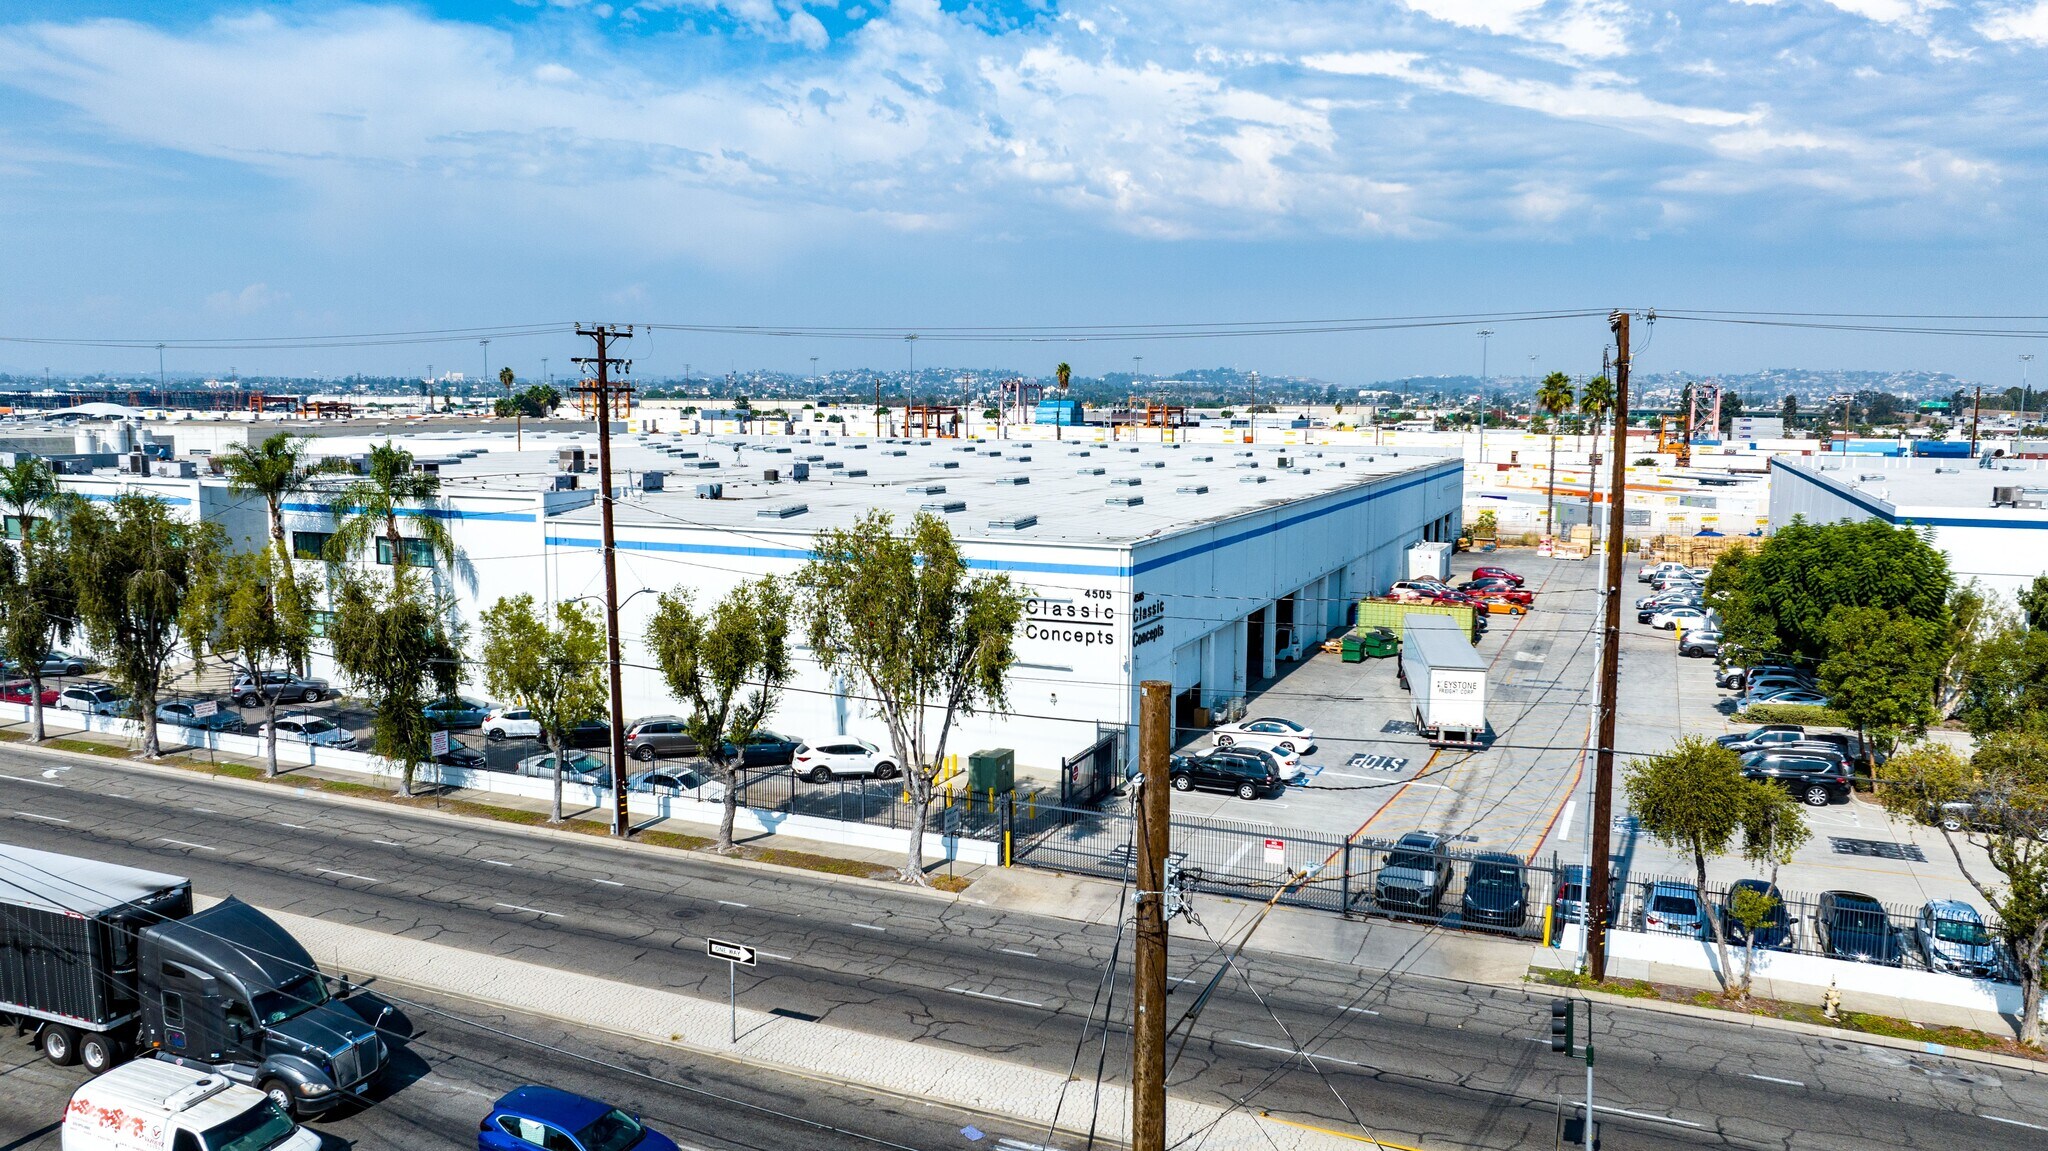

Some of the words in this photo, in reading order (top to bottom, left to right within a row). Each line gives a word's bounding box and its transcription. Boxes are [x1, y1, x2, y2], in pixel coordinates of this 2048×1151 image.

[1084, 589, 1112, 599] 4505
[1025, 599, 1114, 619] Classic
[1133, 600, 1165, 623] Classic
[1025, 624, 1114, 646] Concepts
[1132, 624, 1164, 648] Concepts
[1350, 754, 1404, 772] STOP
[714, 945, 727, 954] ONE
[728, 948, 741, 957] WAY
